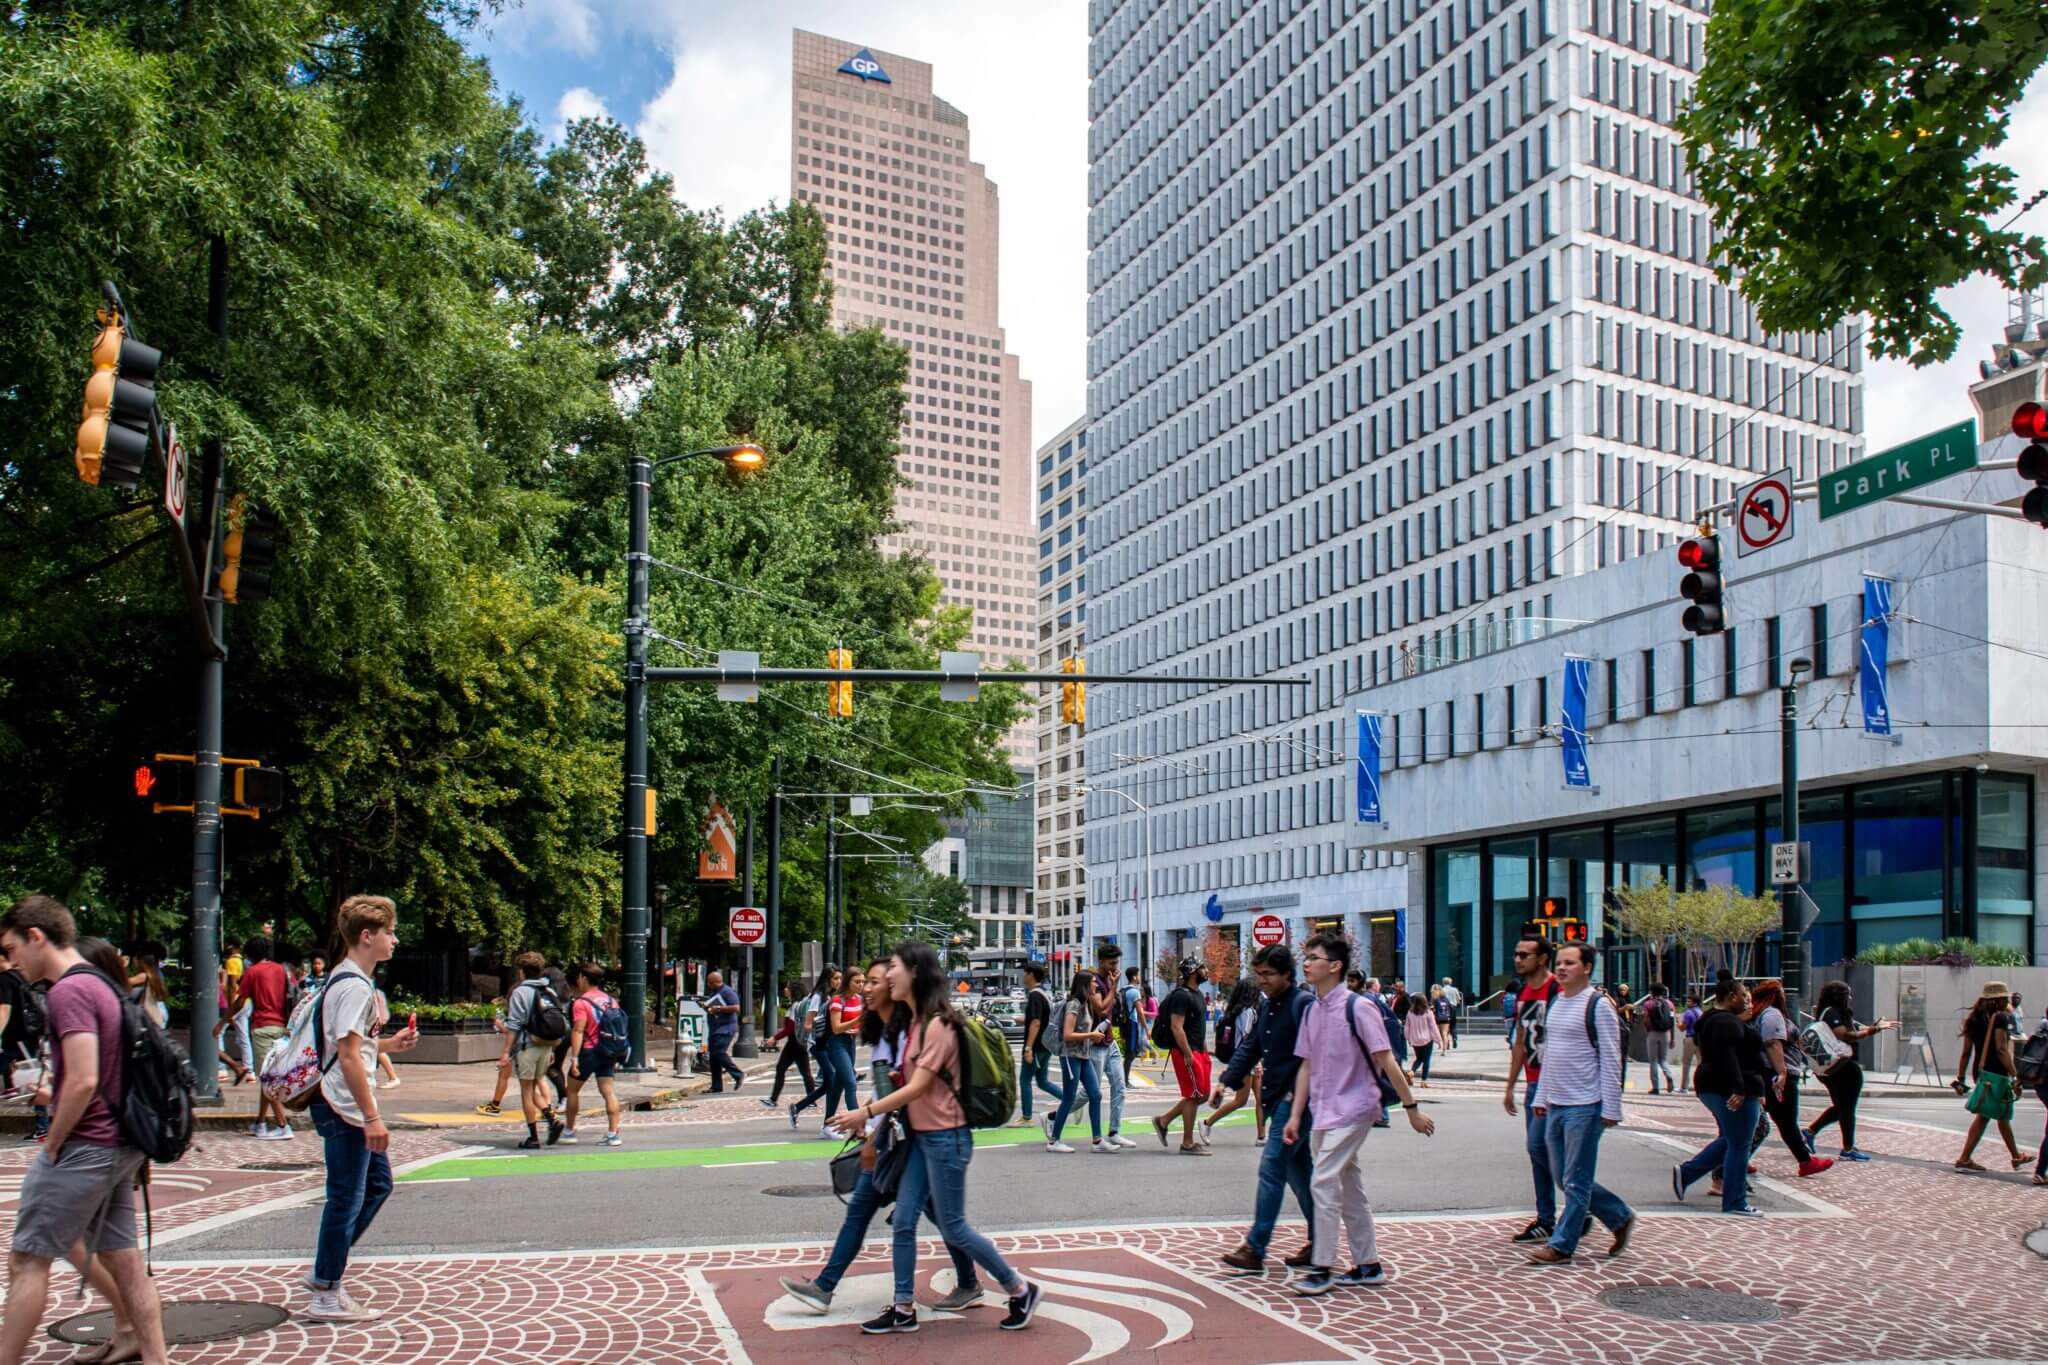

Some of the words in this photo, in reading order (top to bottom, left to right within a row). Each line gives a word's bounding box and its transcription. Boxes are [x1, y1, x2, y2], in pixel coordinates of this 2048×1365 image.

[851, 58, 879, 74] GP
[1834, 458, 1911, 504] Park
[1930, 443, 1956, 467] PL
[1776, 845, 1793, 856] ONE
[1775, 857, 1793, 868] WAY
[737, 929, 758, 937] ENTER
